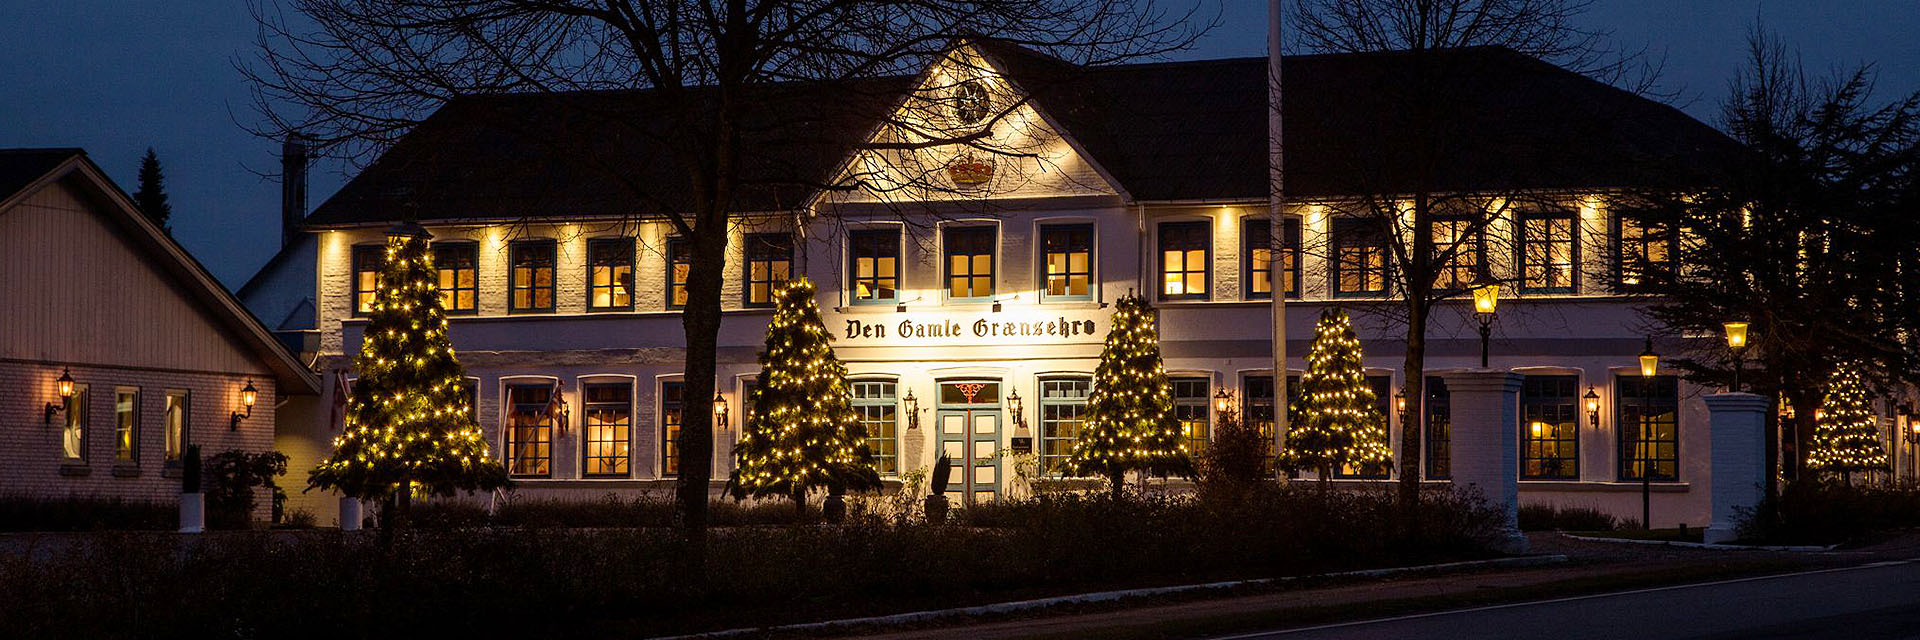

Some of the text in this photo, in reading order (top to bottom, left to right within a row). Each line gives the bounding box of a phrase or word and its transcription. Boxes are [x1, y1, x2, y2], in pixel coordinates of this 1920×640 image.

[845, 317, 1096, 339] Den Gamle Grænsekro
